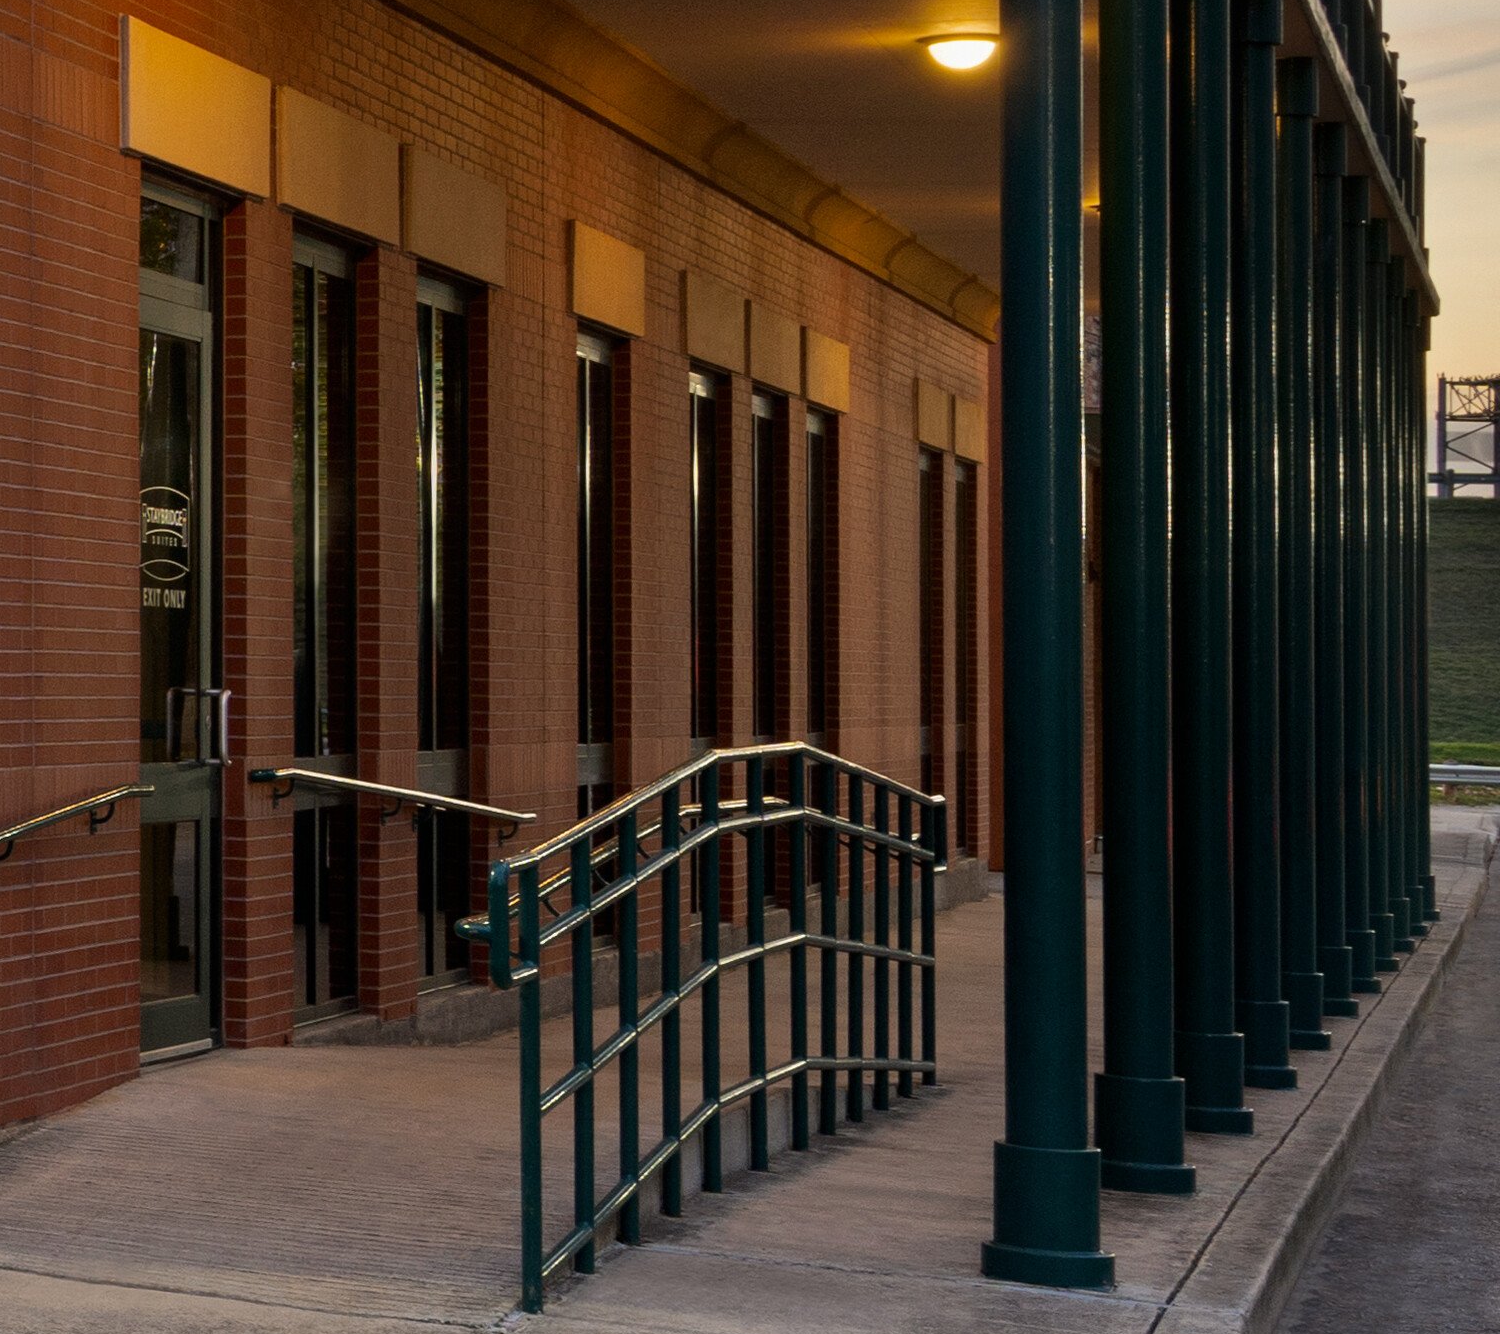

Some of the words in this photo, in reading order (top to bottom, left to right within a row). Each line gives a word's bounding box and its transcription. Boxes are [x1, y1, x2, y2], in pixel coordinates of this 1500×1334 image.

[147, 507, 183, 526] STAYBRIDGE
[152, 536, 177, 547] SUITES
[143, 587, 161, 607] EXIT
[163, 588, 186, 609] ONLY
